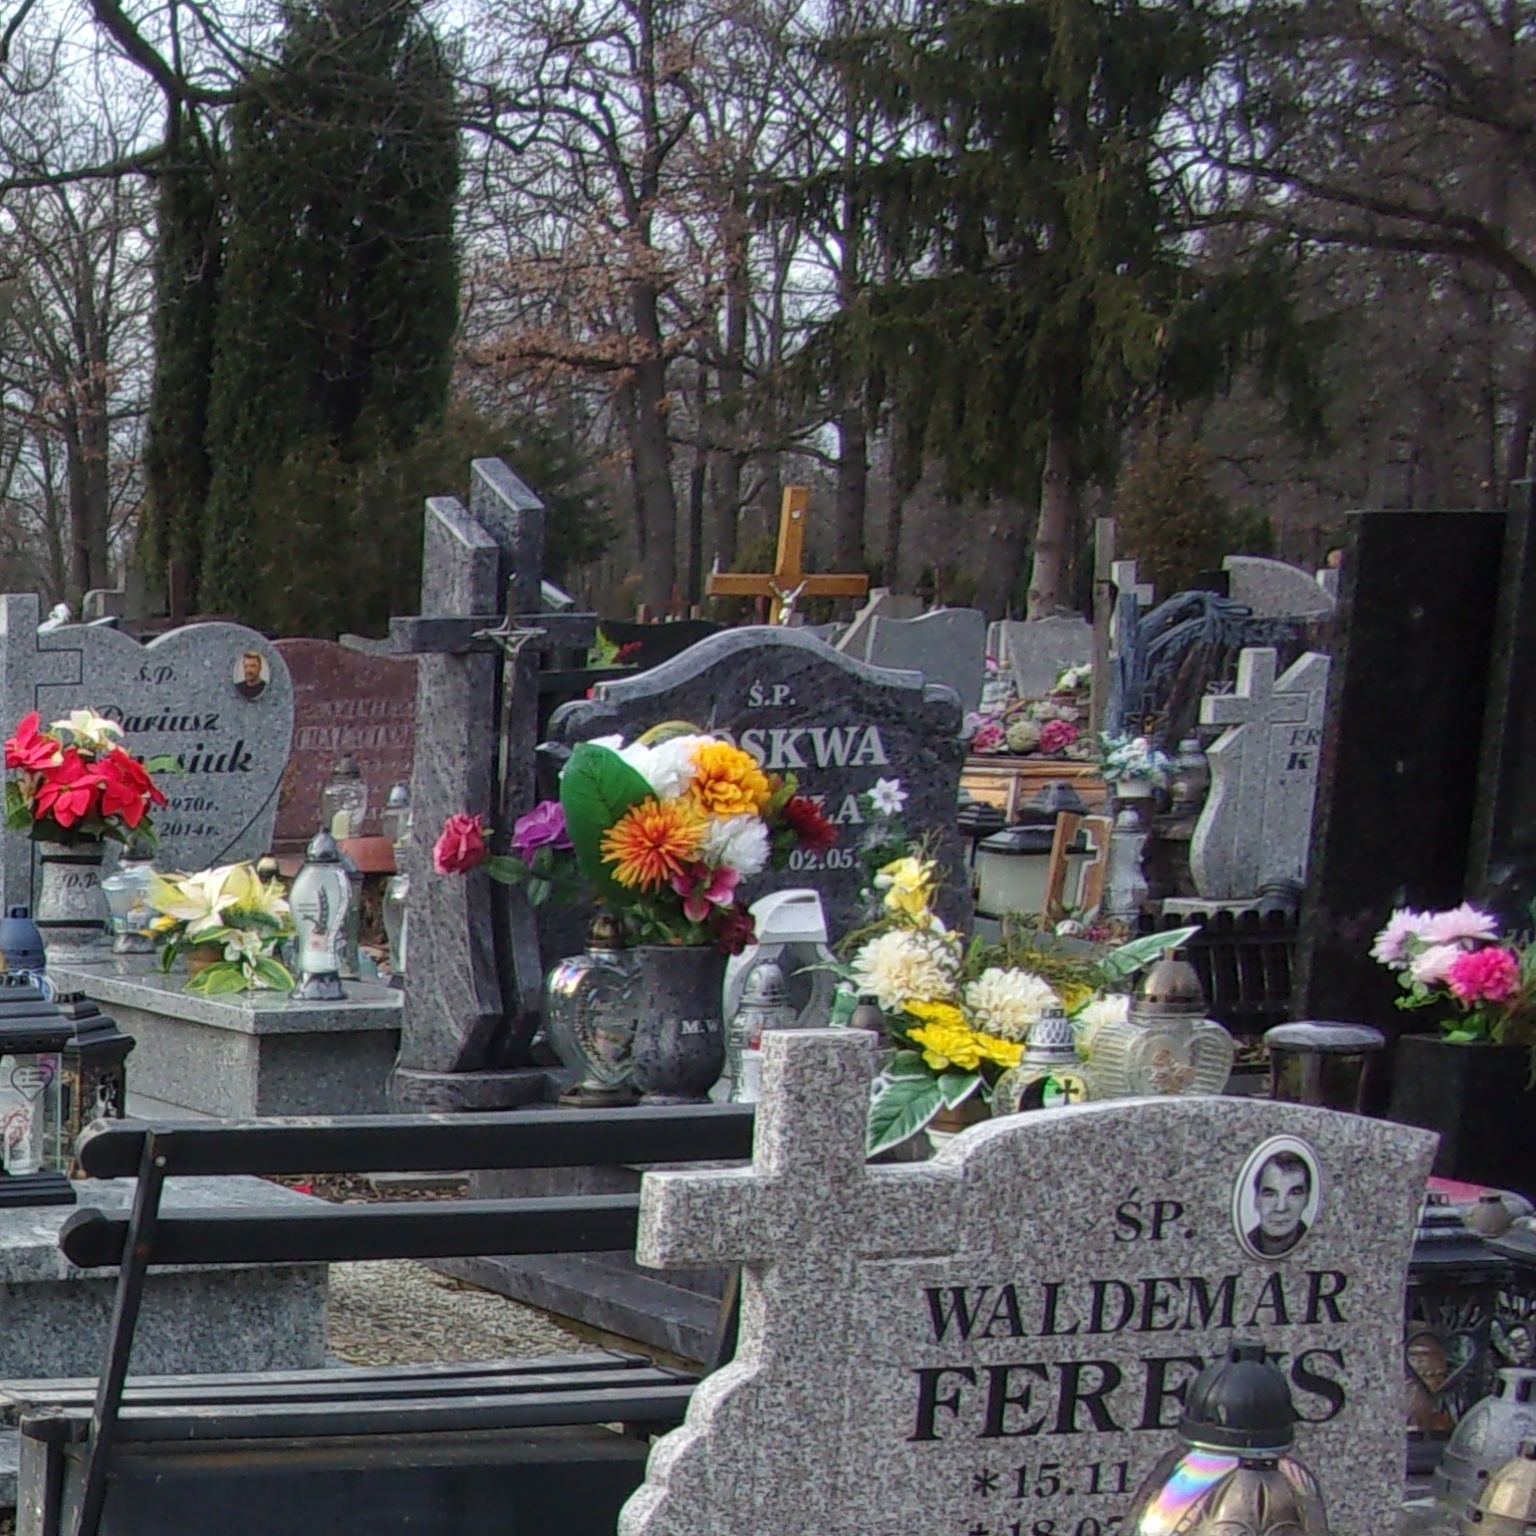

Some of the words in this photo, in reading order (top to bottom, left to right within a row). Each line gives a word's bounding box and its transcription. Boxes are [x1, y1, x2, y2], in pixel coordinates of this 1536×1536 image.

[748, 679, 797, 707] Ś.P.
[711, 726, 889, 769] SKWA
[924, 1268, 1348, 1343] WALDEMAR
[906, 1347, 1348, 1442] FERES
[1010, 1460, 1135, 1499] 15.11
